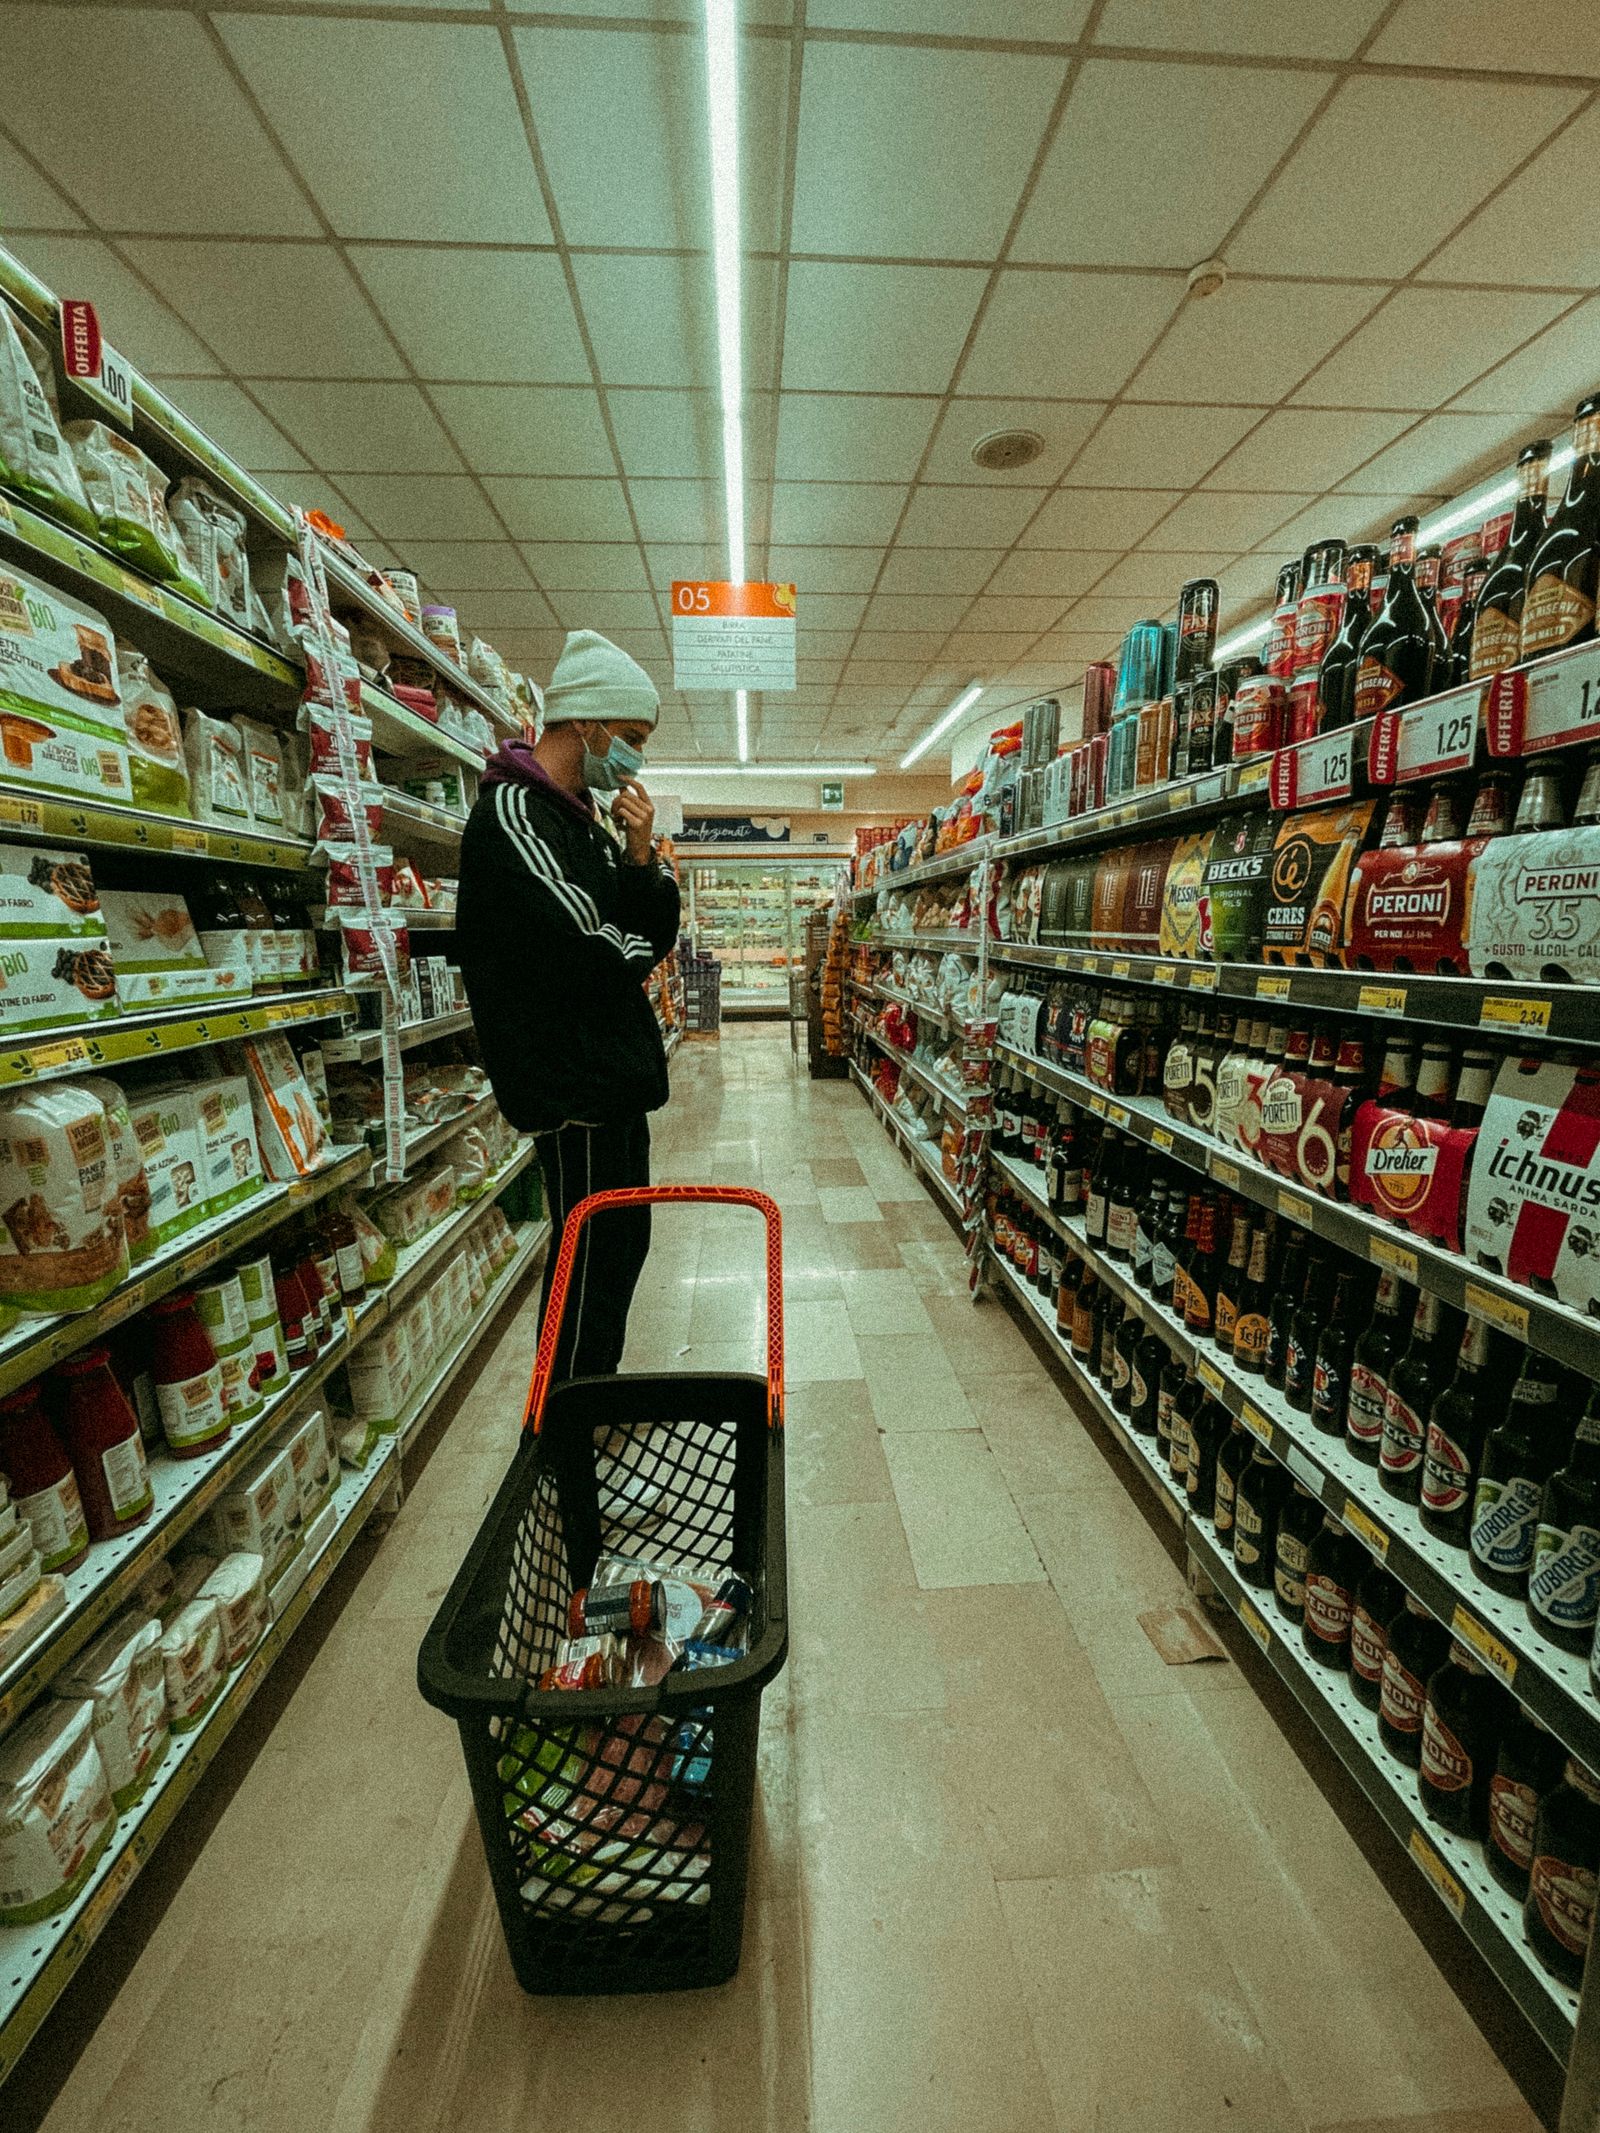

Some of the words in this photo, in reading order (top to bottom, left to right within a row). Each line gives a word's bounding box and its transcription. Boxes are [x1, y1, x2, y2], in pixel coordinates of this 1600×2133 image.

[73, 305, 91, 374] OFFERTA
[679, 587, 710, 611] 05
[1536, 601, 1581, 617] RISERVA
[1363, 678, 1393, 691] RISERVA
[1498, 674, 1515, 753] OFFERTA
[1376, 714, 1393, 780] OFFERTA
[1436, 714, 1473, 756] 1,25
[80, 757, 100, 777] BIO
[1323, 752, 1348, 785] 1,25
[1278, 752, 1291, 807] OFFERTA
[1208, 856, 1264, 881] BECK'S
[1213, 888, 1254, 897] ORIGINAL
[1524, 872, 1600, 893] PERONI
[7, 898, 34, 909] FARRO
[1372, 891, 1443, 914] PERONI
[1267, 906, 1306, 925] CERES
[1374, 930, 1389, 939] PER
[1389, 930, 1403, 938] NOI
[2, 952, 29, 978] BIO
[30, 992, 57, 1004] FARRO
[1385, 998, 1403, 1009] 2,34
[1520, 1010, 1544, 1027] 2,34
[65, 1047, 85, 1063] 2,95
[1188, 1058, 1217, 1127] 5
[161, 1112, 180, 1137] BIO
[1263, 1101, 1298, 1124] PORETTI
[1297, 1097, 1336, 1187] 6
[1373, 1146, 1428, 1171] Dreher
[1509, 1183, 1549, 1203] ANIMA
[1553, 1199, 1598, 1221] SARDA
[1473, 1496, 1531, 1552] TUBORG
[1531, 1545, 1596, 1603] TUBORG
